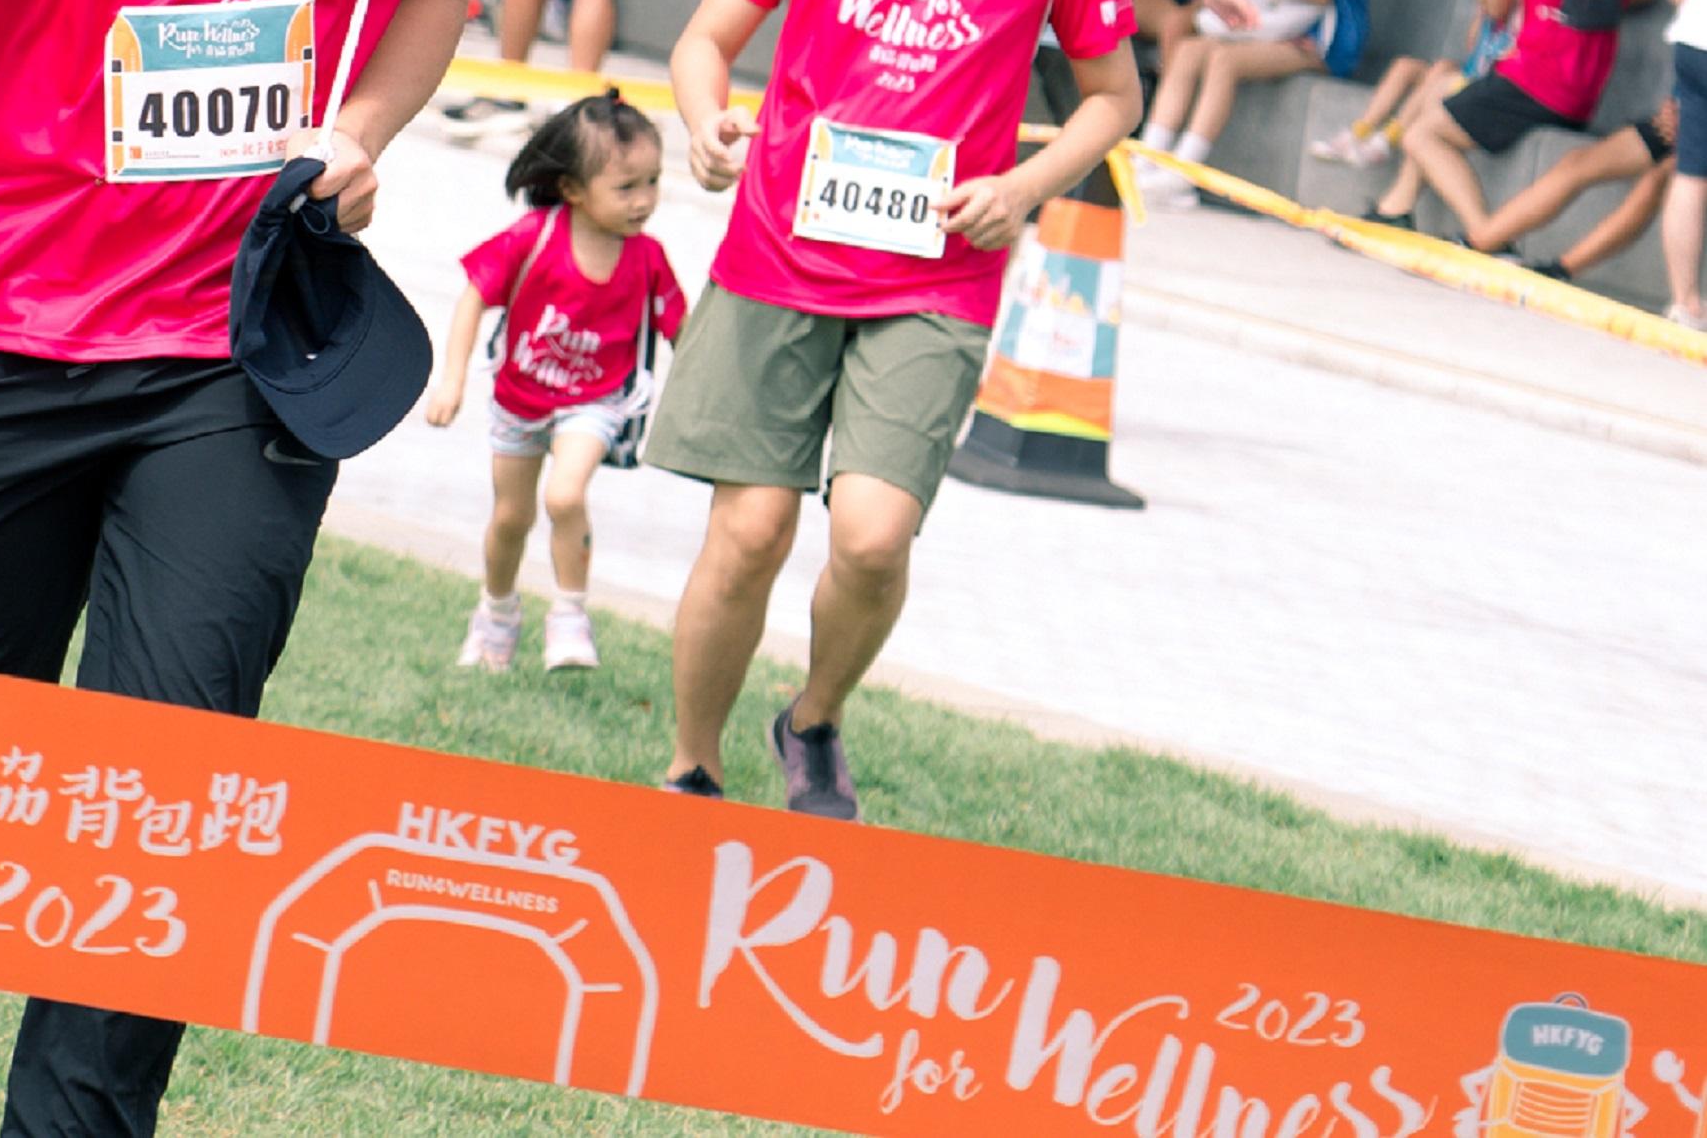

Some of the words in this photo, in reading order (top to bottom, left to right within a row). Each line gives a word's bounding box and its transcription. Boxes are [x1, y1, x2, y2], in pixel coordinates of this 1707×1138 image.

[158, 22, 202, 50] Run
[138, 83, 290, 138] 40070
[819, 178, 929, 224] 40480
[397, 801, 581, 865] HKFYG
[386, 868, 560, 914] RUN4WELLNESS
[698, 841, 1015, 1059] Run
[1005, 955, 1439, 1138] Wellness
[1215, 982, 1366, 1048] 2023
[1531, 1024, 1605, 1056] HKFYG
[880, 1028, 985, 1113] for
